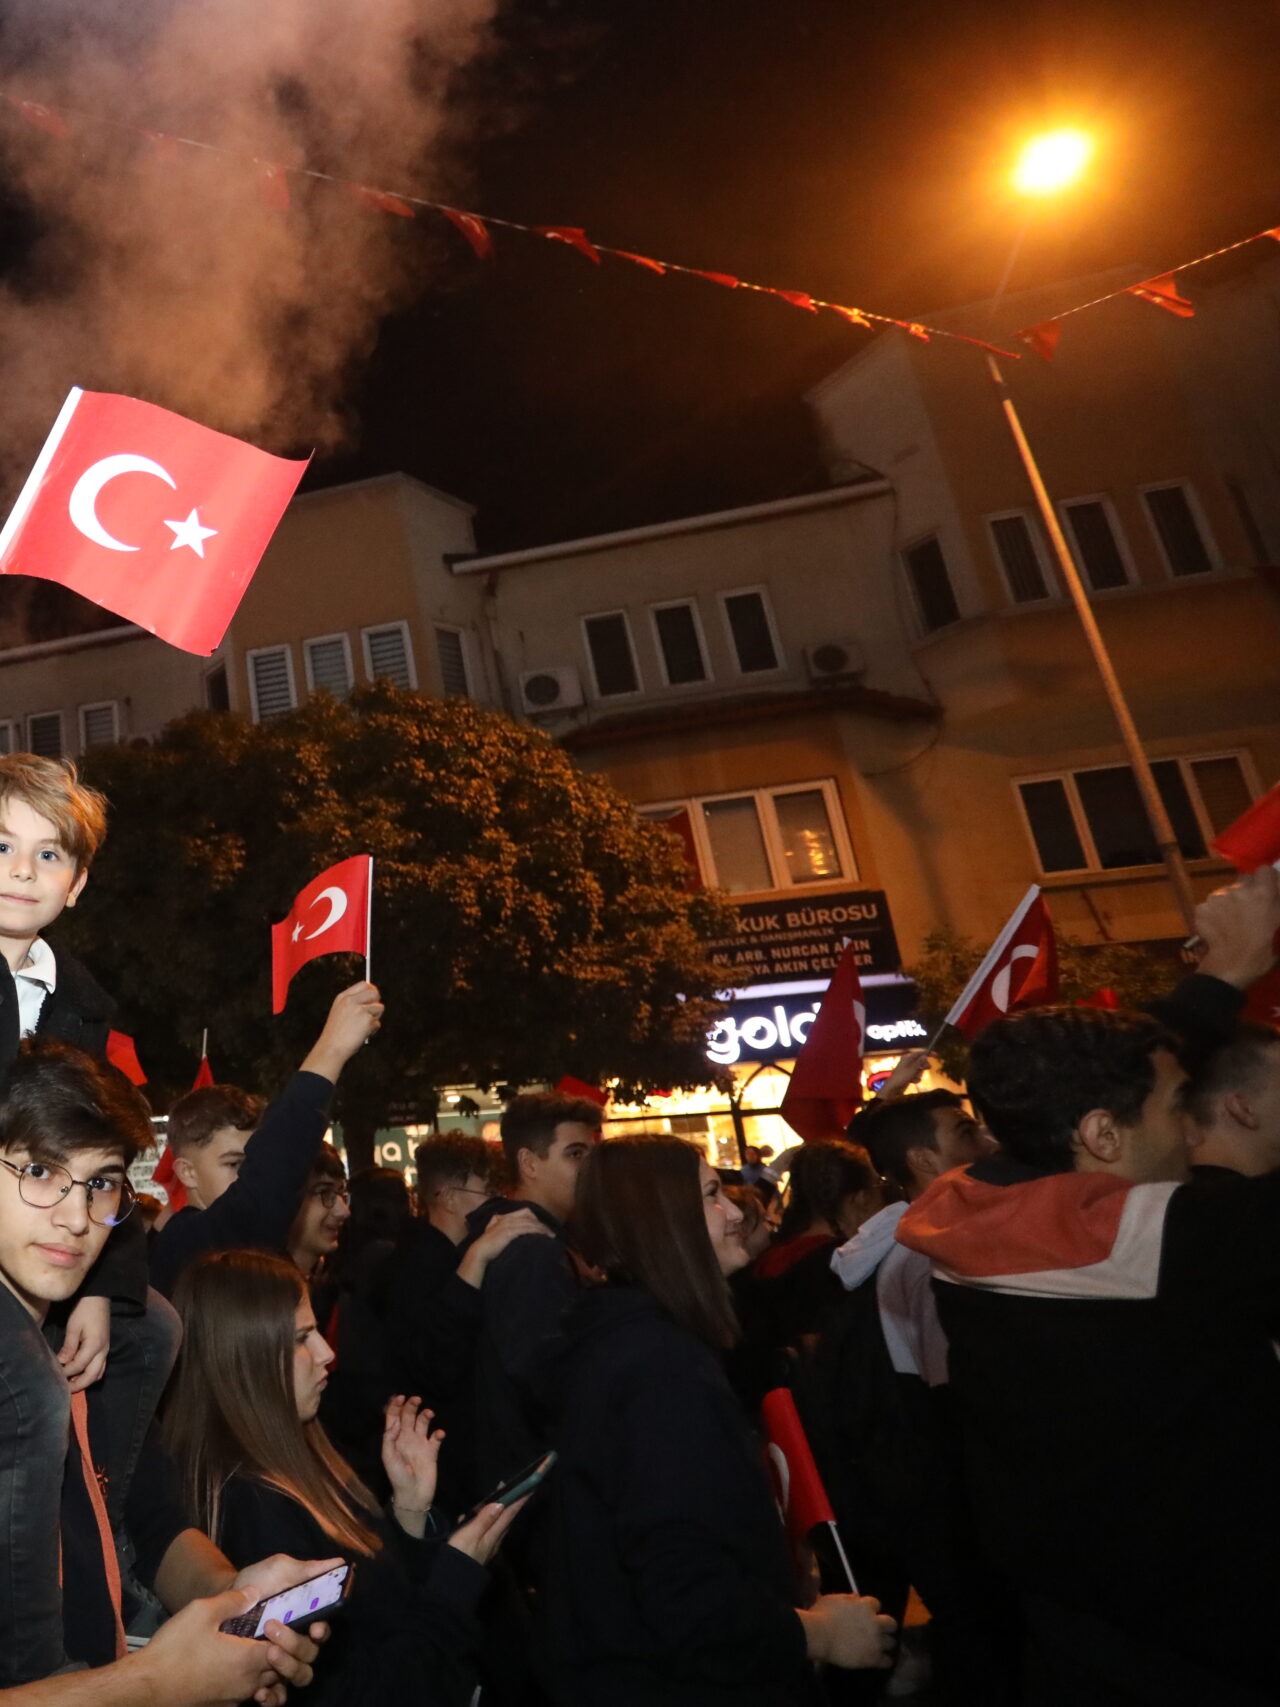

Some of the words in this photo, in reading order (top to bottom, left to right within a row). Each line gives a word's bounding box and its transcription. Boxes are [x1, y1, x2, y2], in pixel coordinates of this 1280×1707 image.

[736, 913, 781, 934] KUK
[786, 903, 879, 928] BÜROSU
[771, 943, 830, 960] NURCAN
[834, 938, 871, 954] AIN
[774, 959, 808, 974] AKIN
[811, 953, 873, 973] ÇELER
